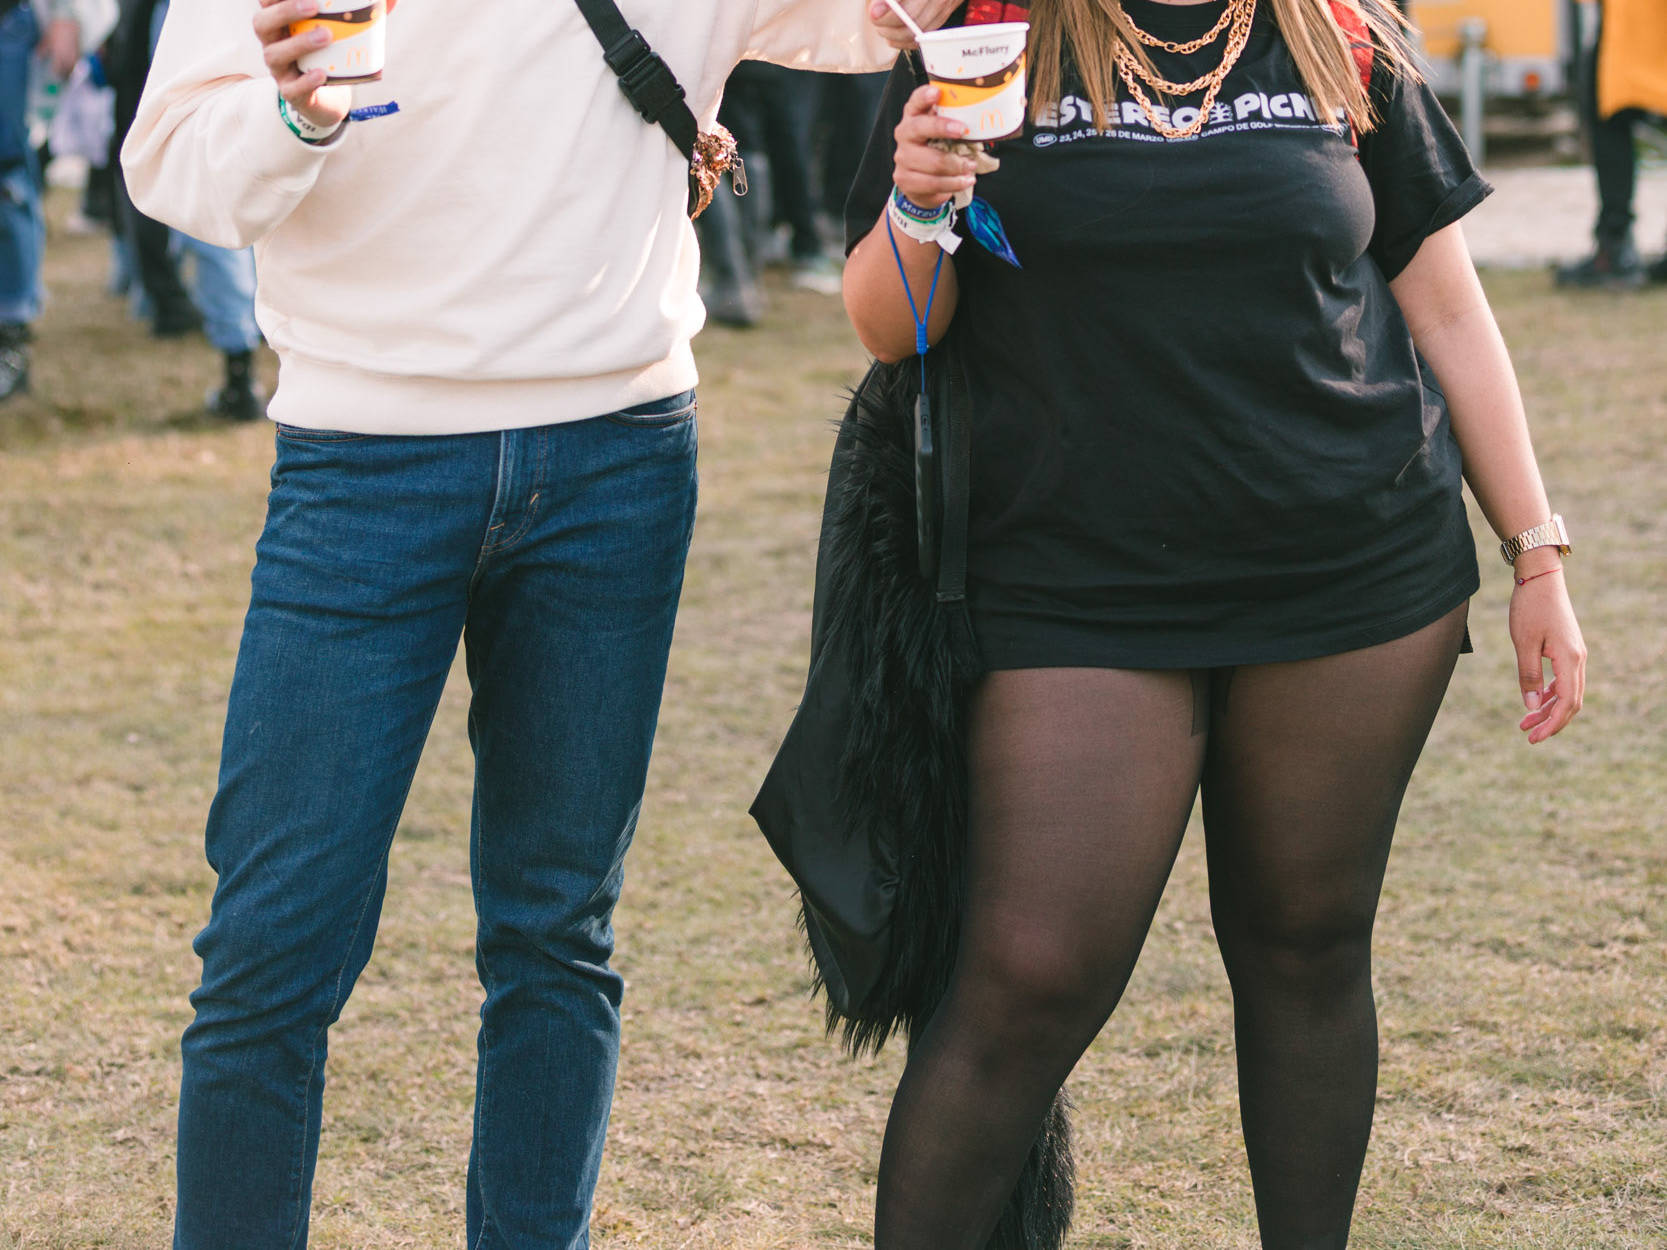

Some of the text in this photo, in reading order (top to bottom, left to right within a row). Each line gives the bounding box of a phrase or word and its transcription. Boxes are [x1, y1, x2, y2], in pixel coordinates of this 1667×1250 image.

[962, 46, 1009, 57] McFlurry
[1118, 130, 1131, 139] DE
[1132, 131, 1164, 143] MARZO
[1201, 124, 1235, 138] CAMPO
[1236, 122, 1250, 131] DE
[901, 201, 937, 217] Marzo
